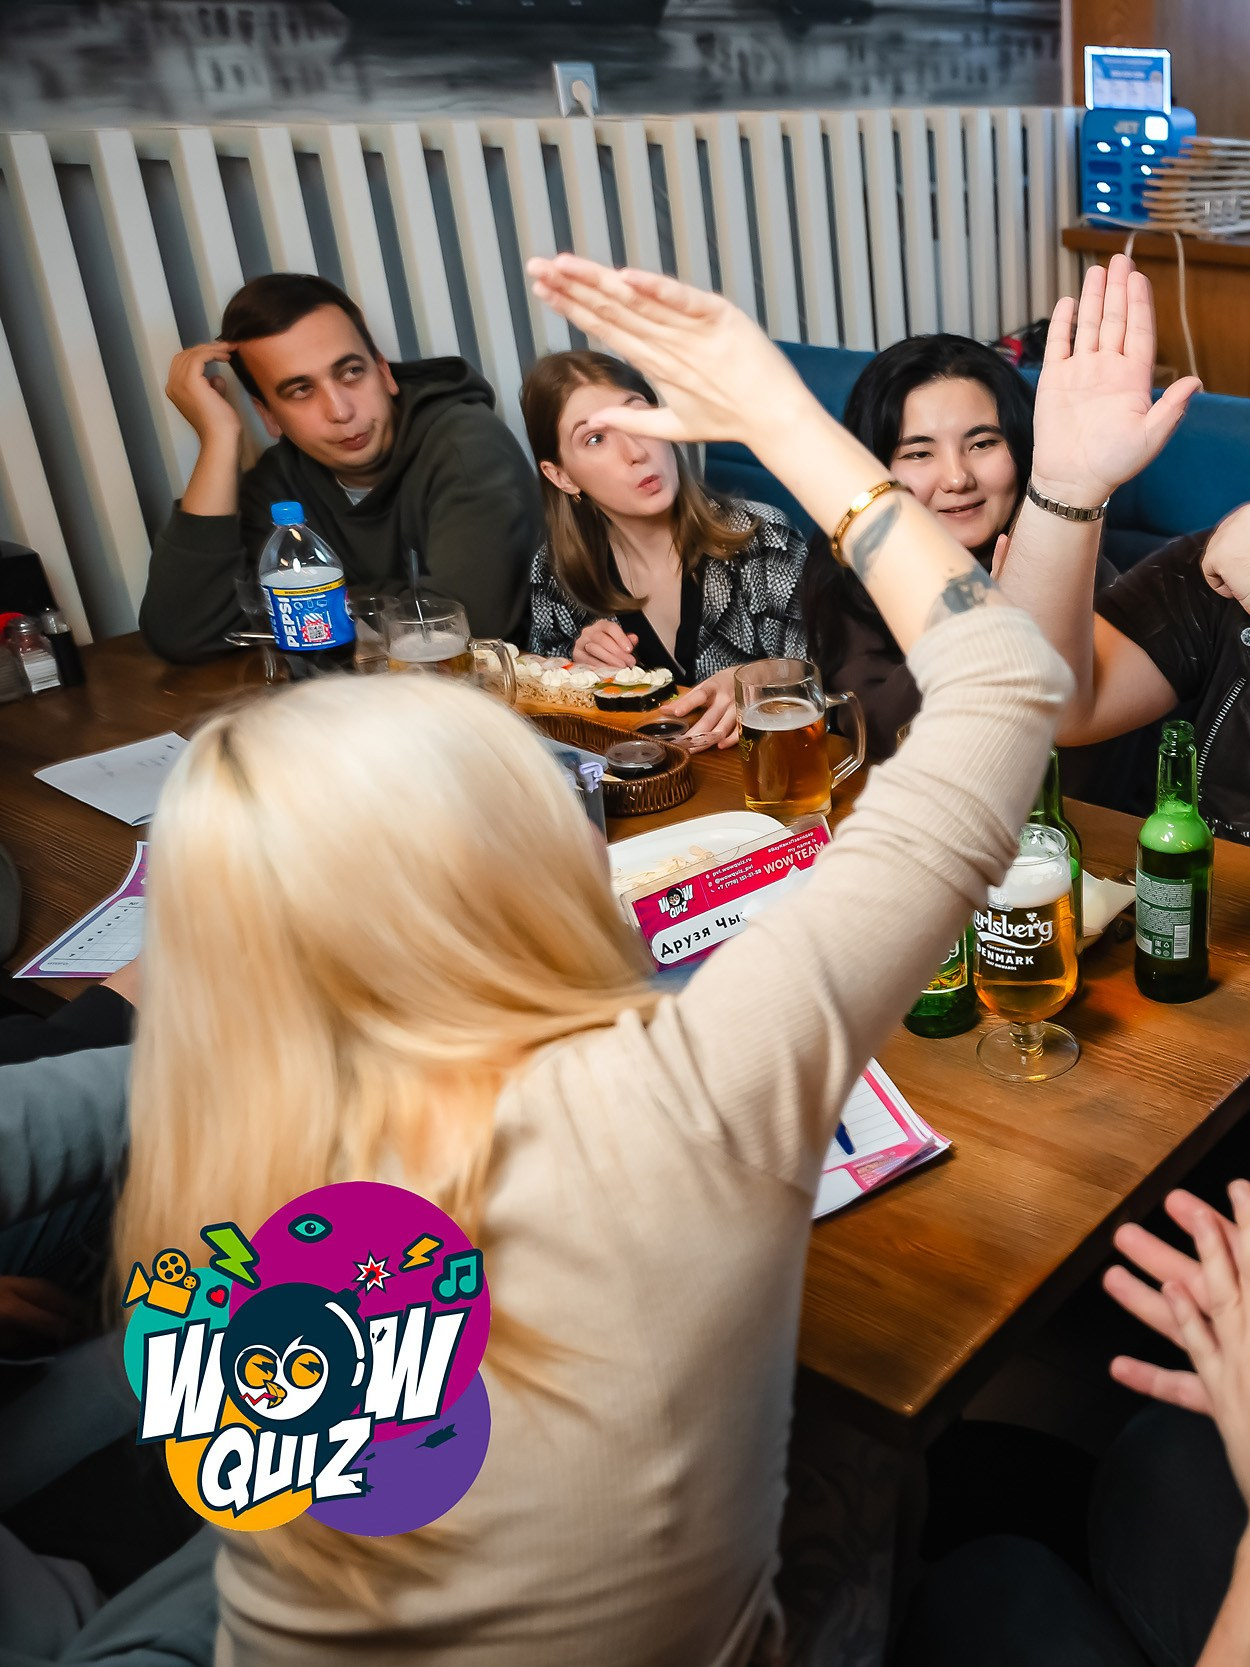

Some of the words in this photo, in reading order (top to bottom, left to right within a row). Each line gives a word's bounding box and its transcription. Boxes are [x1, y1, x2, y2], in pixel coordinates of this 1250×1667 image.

[277, 597, 300, 647] PEPSI
[763, 854, 795, 875] WOW
[795, 841, 825, 861] TEAM
[797, 840, 811, 849] name
[669, 901, 688, 918] QUIZ
[660, 927, 711, 958] Друзя
[715, 912, 748, 929] Чы
[976, 942, 1034, 965] DENMARK
